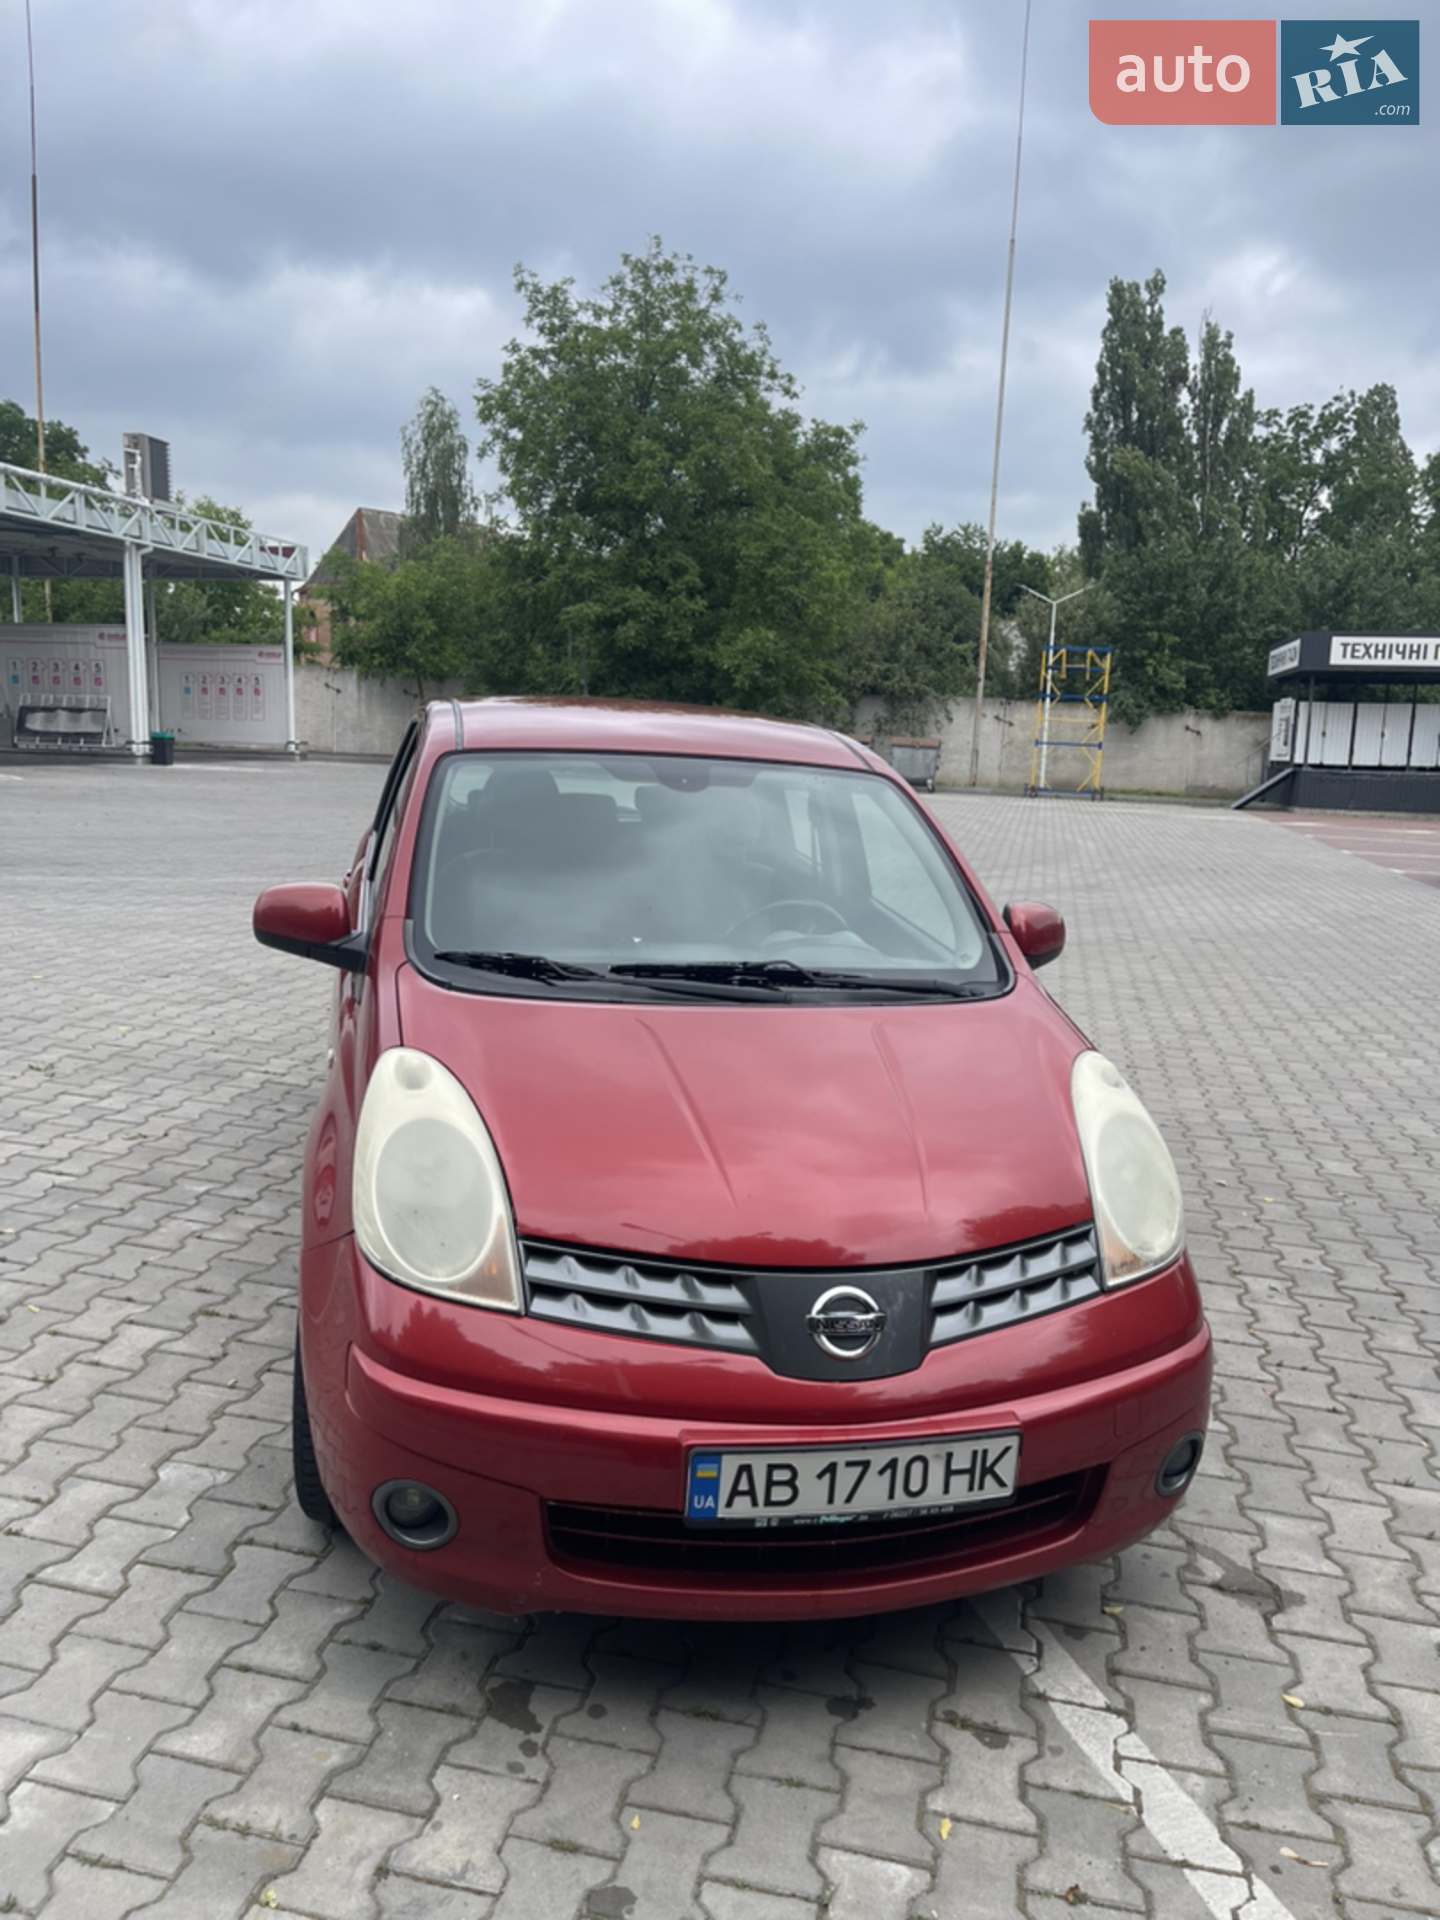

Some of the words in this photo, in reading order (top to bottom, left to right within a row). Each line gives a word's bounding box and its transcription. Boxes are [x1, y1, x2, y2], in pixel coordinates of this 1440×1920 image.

[1341, 642, 1428, 660] ТЕХНІЧНІ
[31, 661, 39, 672] 2
[73, 663, 80, 672] 4
[724, 1463, 800, 1509] AB
[815, 1454, 930, 1505] 1710
[942, 1445, 1013, 1496] HK
[693, 1494, 716, 1510] UA
